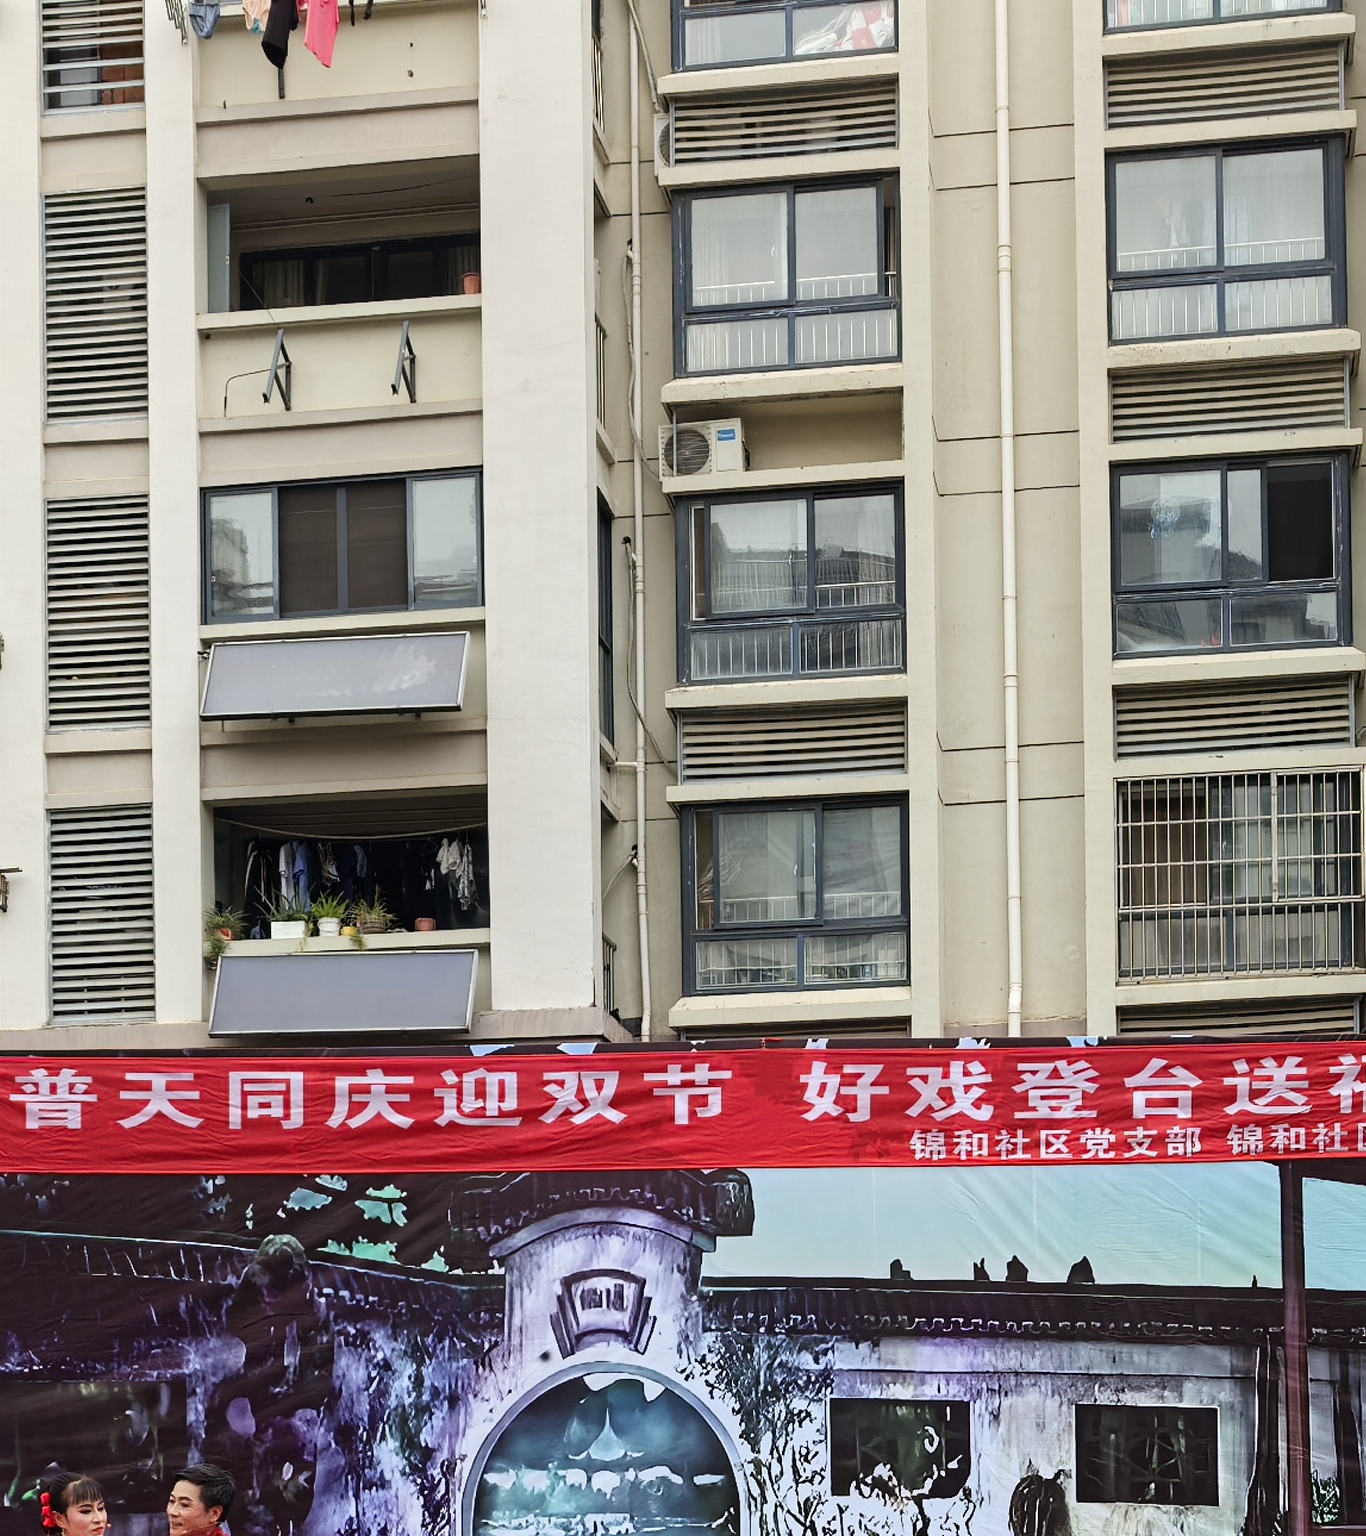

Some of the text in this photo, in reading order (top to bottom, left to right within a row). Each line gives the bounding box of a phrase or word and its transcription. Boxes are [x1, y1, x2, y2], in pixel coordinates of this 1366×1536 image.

[8, 1064, 733, 1130] 普天同庆迎双节
[909, 1126, 1202, 1160] 锦和社区党支部
